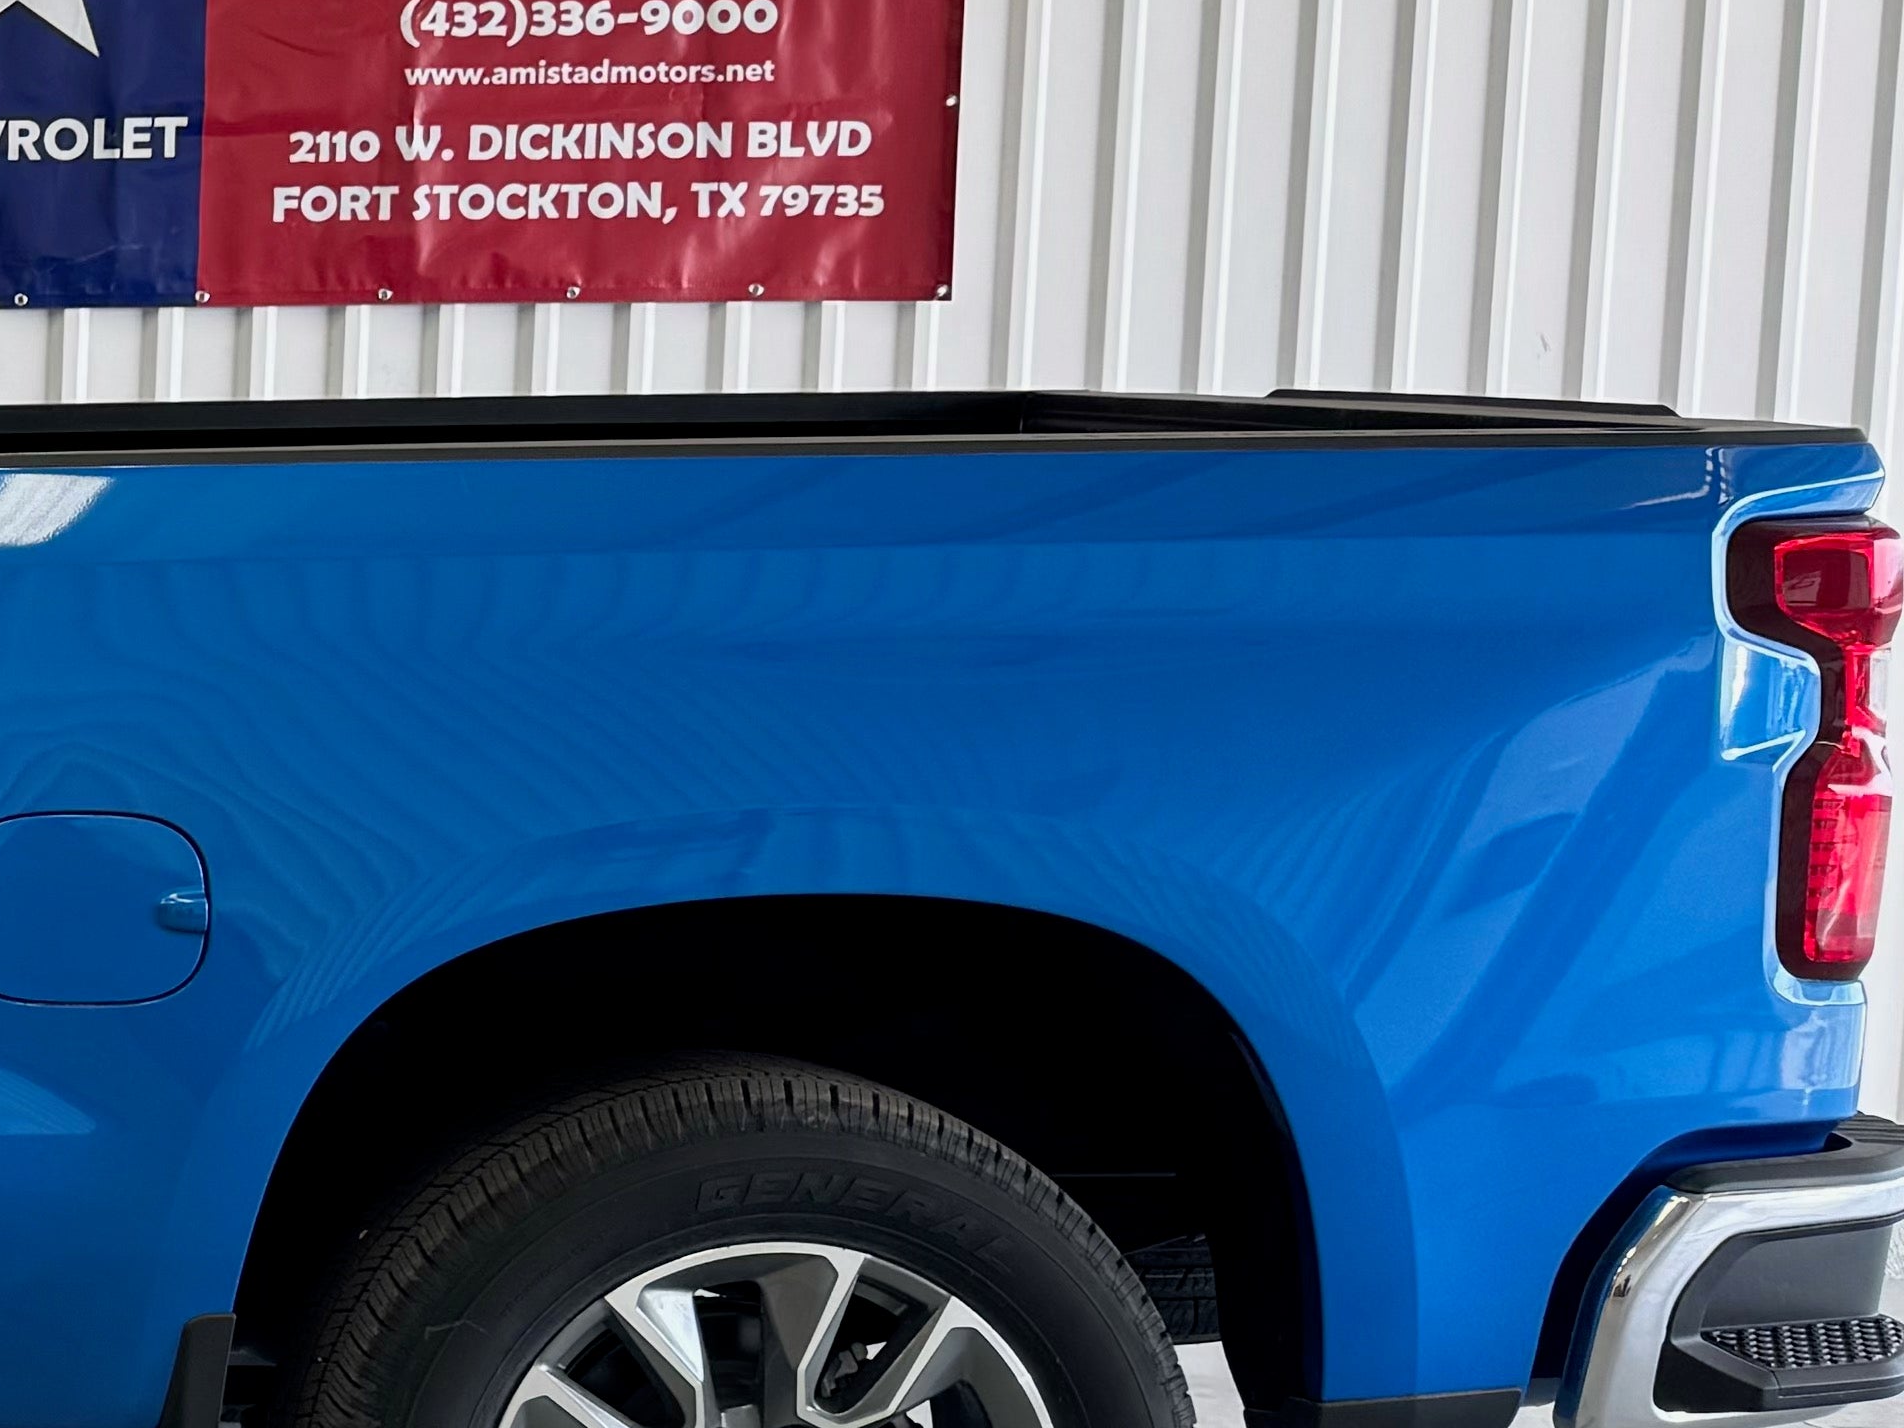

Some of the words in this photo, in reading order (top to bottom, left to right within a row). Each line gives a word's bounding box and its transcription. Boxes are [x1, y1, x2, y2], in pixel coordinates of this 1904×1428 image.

[404, 58, 776, 87] www.amistadmotors.net
[288, 129, 382, 164] 2110
[394, 125, 456, 163] W.
[467, 121, 734, 162] DICKINSON
[746, 120, 873, 159] BLVD
[271, 184, 401, 224] FORT
[411, 181, 679, 226] STOCKTON,
[689, 180, 750, 220] TX
[757, 183, 886, 218] 79735
[695, 1170, 1014, 1274] GENERAL
